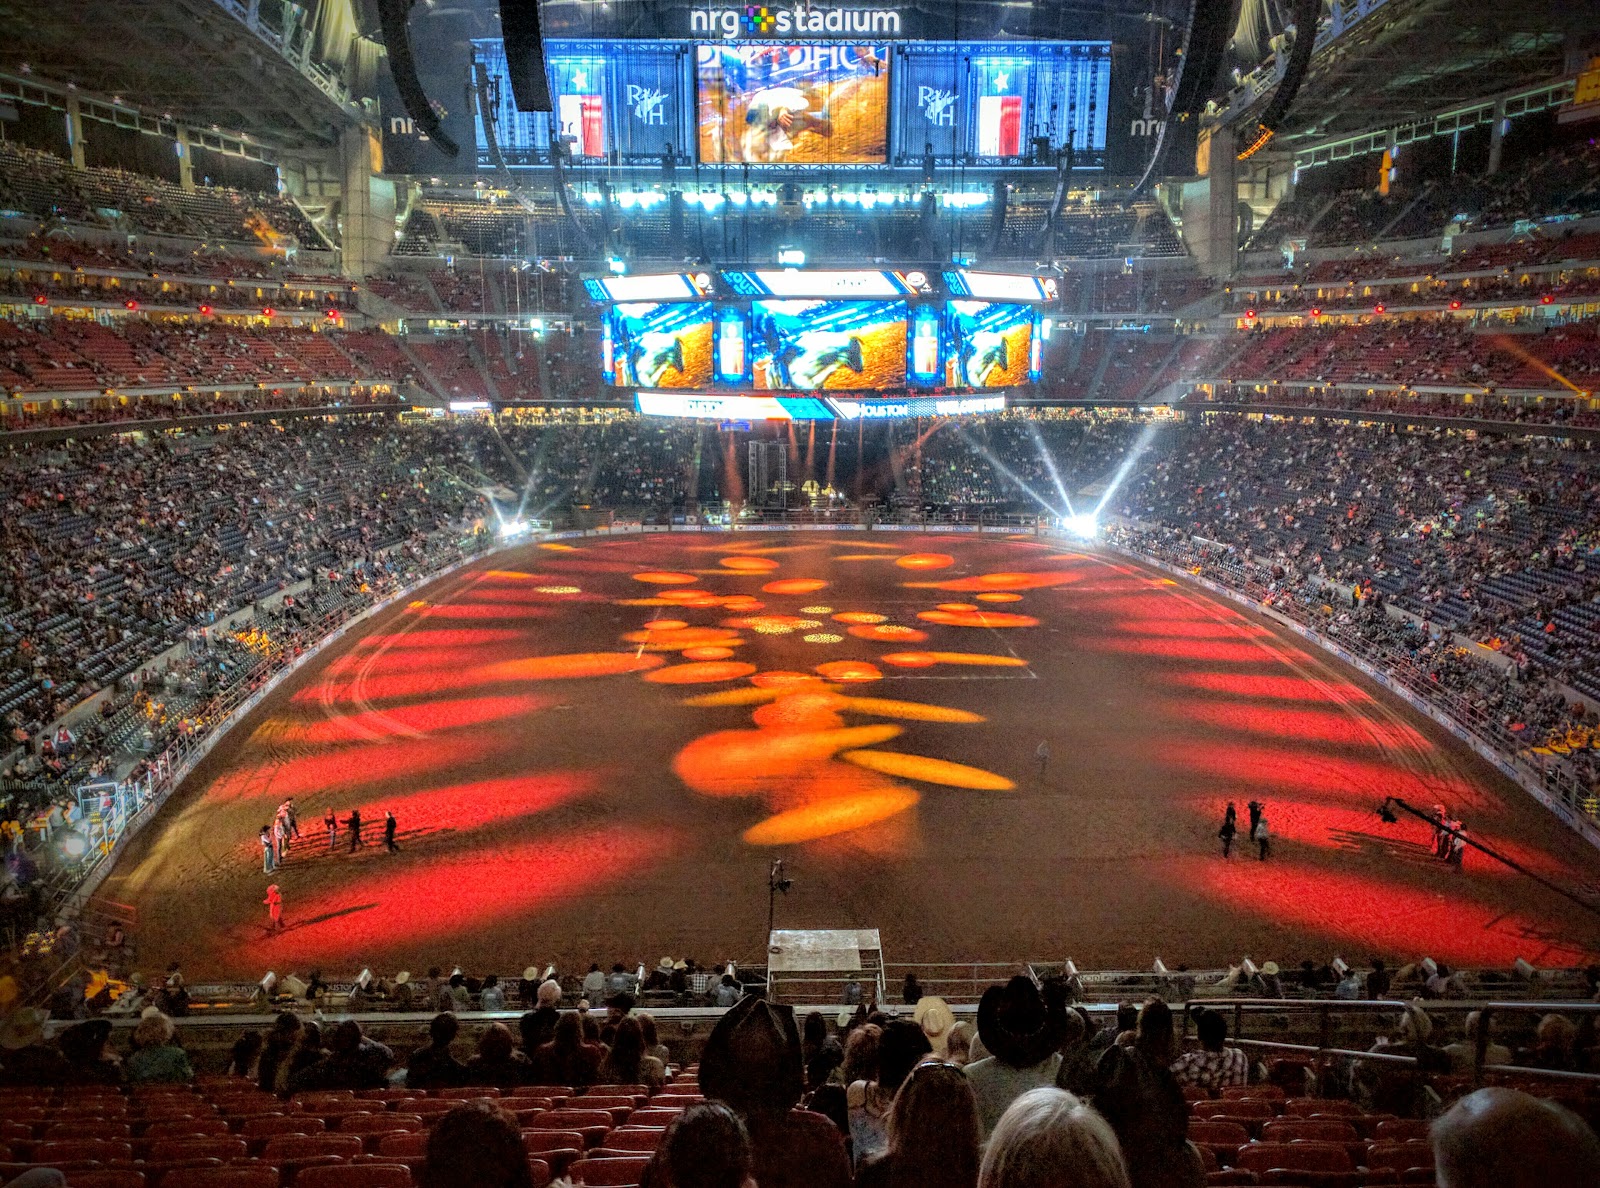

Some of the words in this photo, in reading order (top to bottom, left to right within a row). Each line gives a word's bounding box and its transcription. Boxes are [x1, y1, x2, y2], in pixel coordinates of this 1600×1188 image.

[690, 10, 739, 39] nrg
[775, 6, 901, 33] stadium
[1130, 119, 1162, 136] nr
[858, 402, 908, 417] HOUSTON
